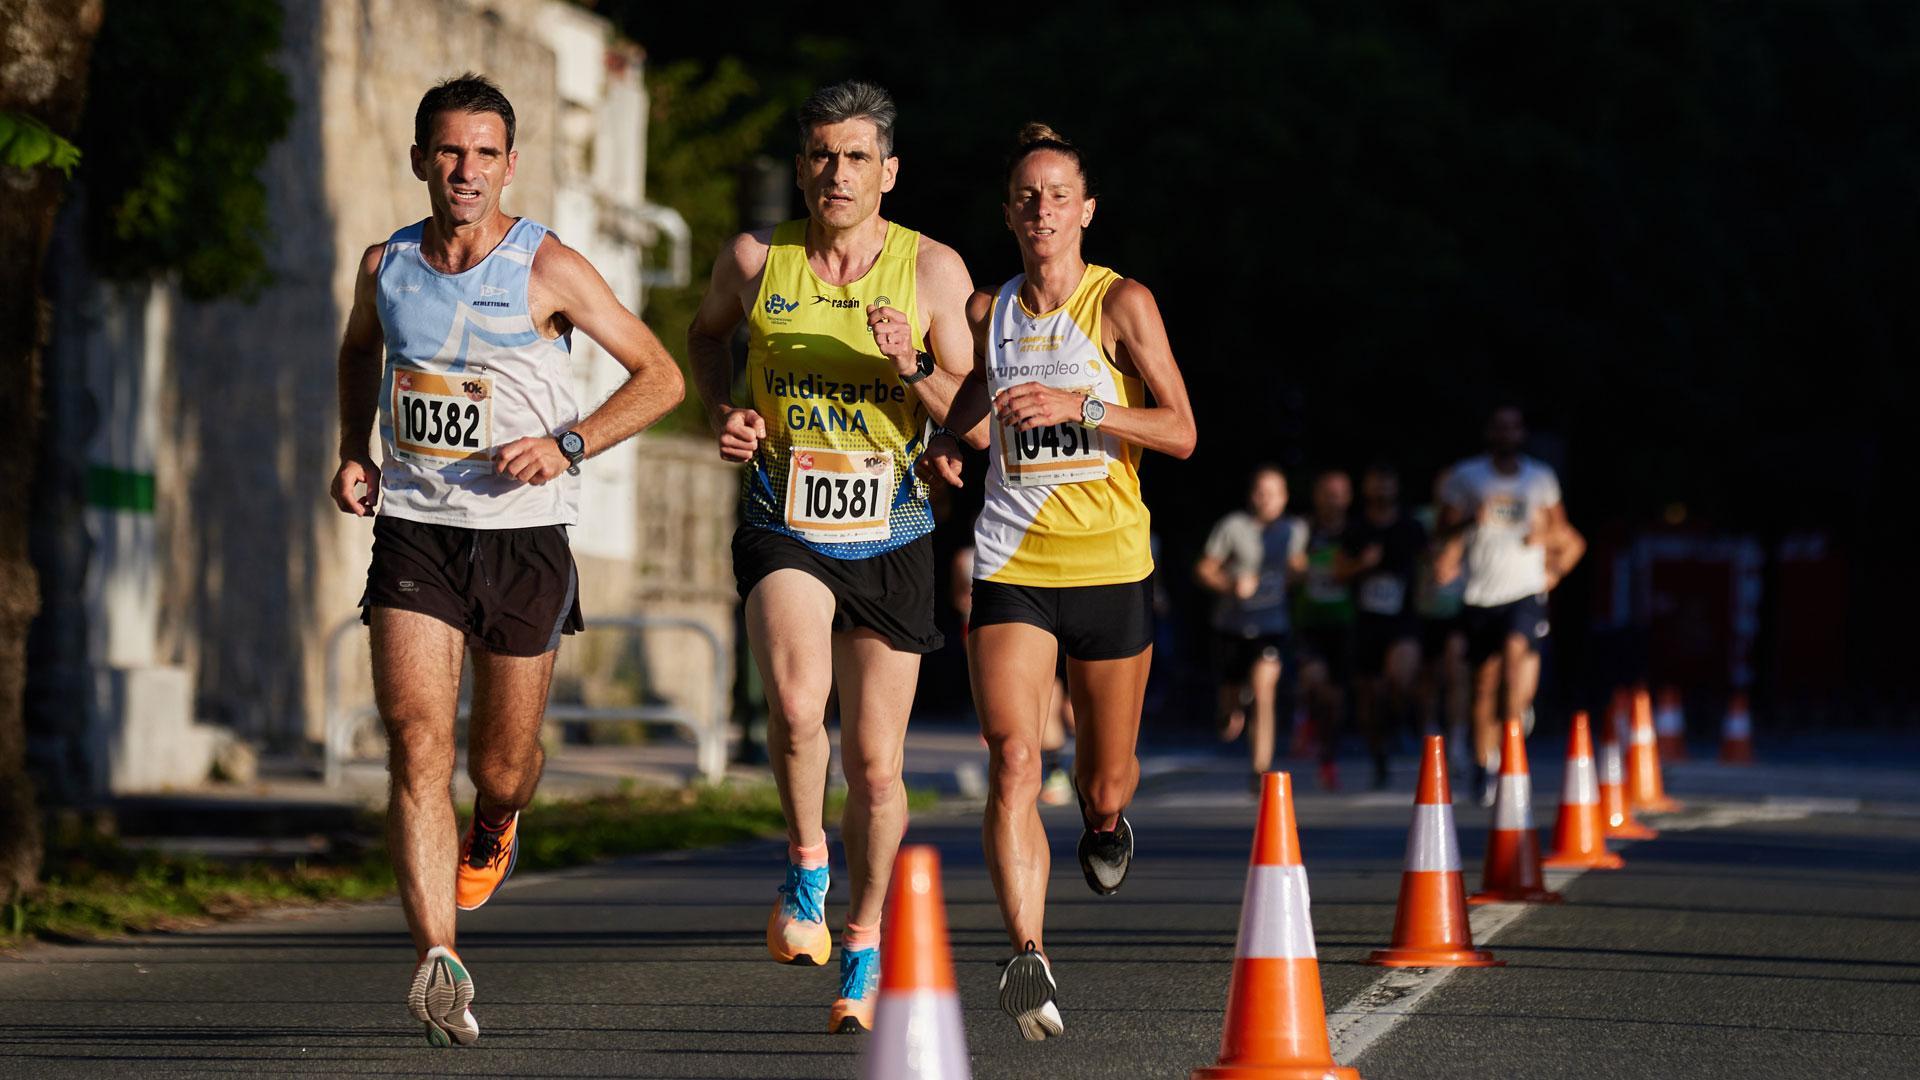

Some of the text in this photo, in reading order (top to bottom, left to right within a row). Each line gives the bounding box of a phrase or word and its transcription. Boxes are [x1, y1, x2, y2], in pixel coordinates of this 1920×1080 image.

[472, 300, 509, 308] ATHLETISME
[831, 297, 859, 308] rasán
[764, 367, 905, 404] Valdizarbe
[987, 361, 1079, 380] grupompleo
[462, 381, 482, 395] 10k
[403, 396, 480, 448] 10382
[787, 404, 869, 434] GANA
[1014, 422, 1089, 460] 10451
[805, 475, 879, 519] 10381
